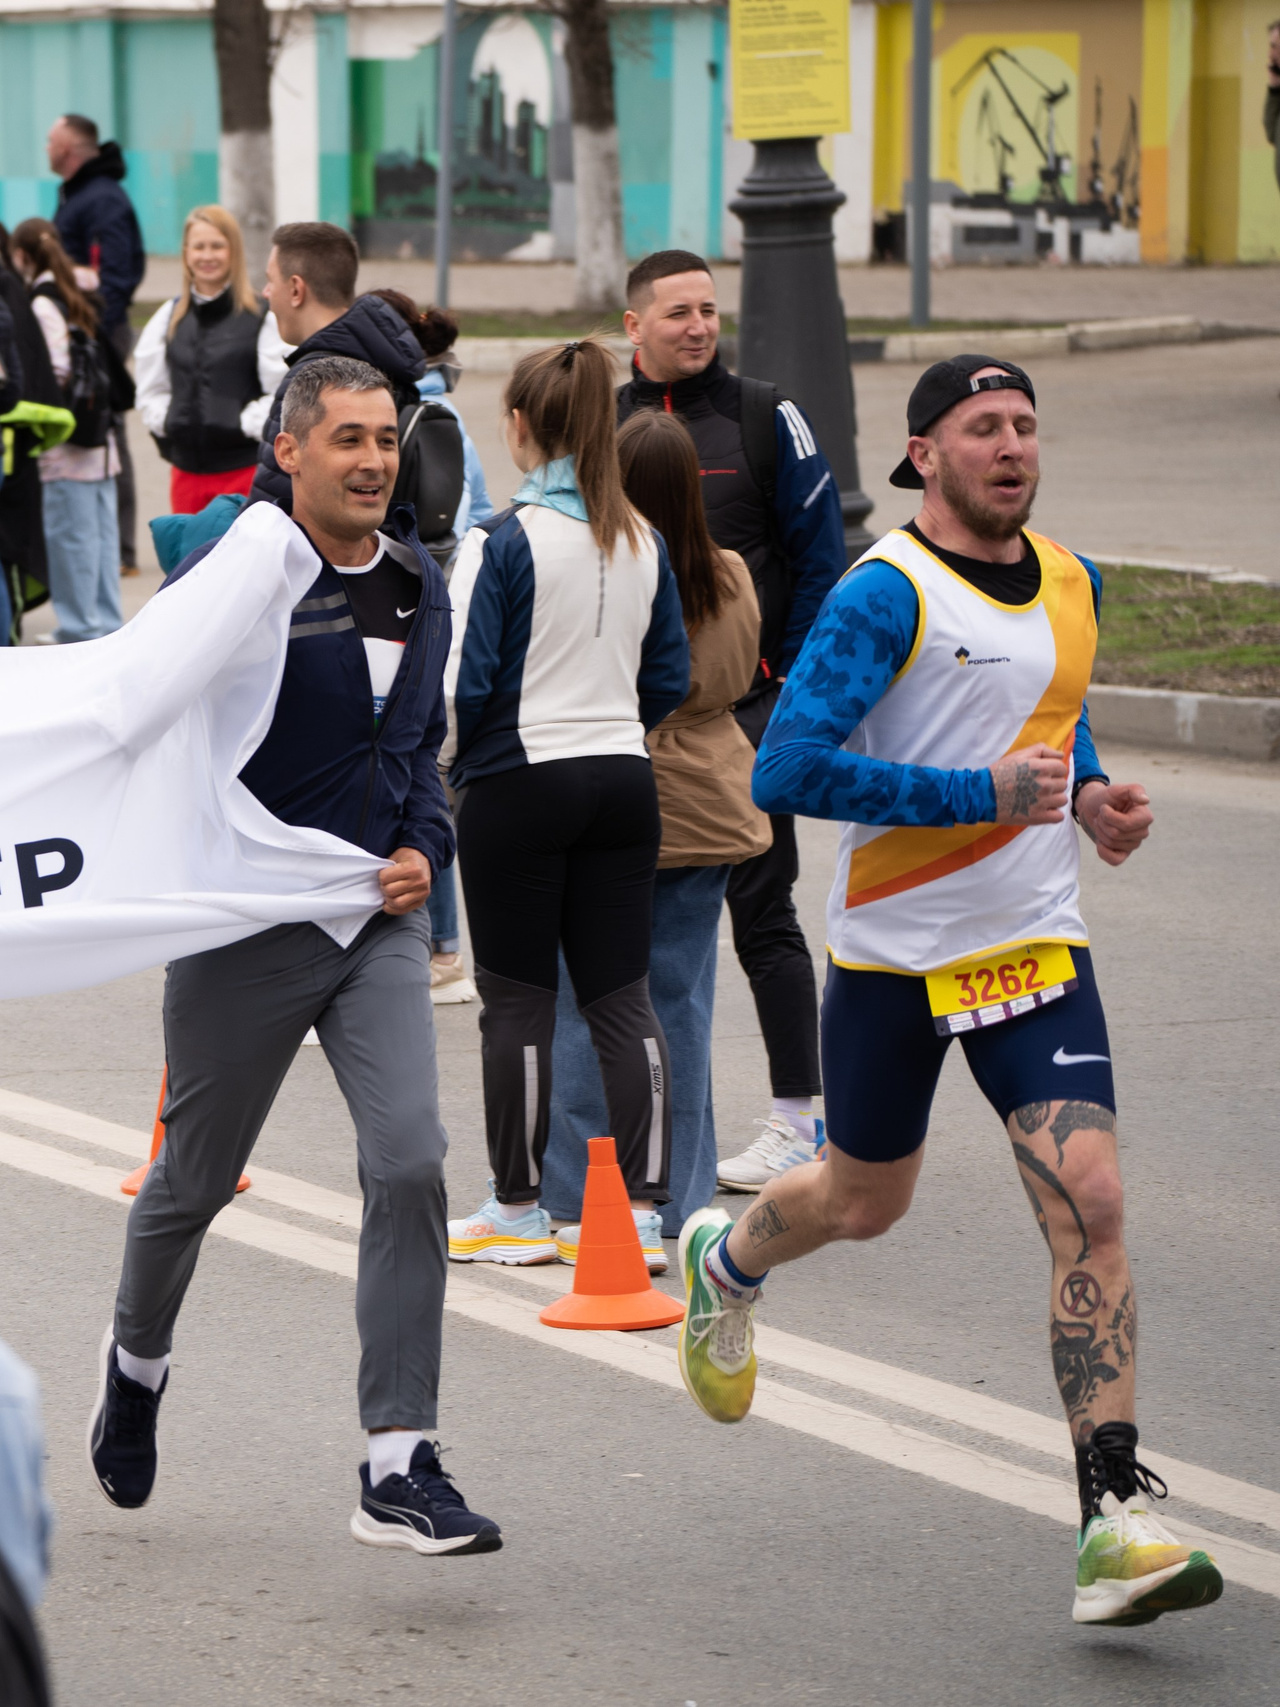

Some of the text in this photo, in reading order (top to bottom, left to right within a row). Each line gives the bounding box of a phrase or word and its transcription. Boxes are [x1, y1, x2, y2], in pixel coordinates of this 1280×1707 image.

[967, 656, 1011, 665] РОСНЕФТЬ
[954, 958, 1046, 1007] 3262
[464, 1222, 497, 1237] HOKA
